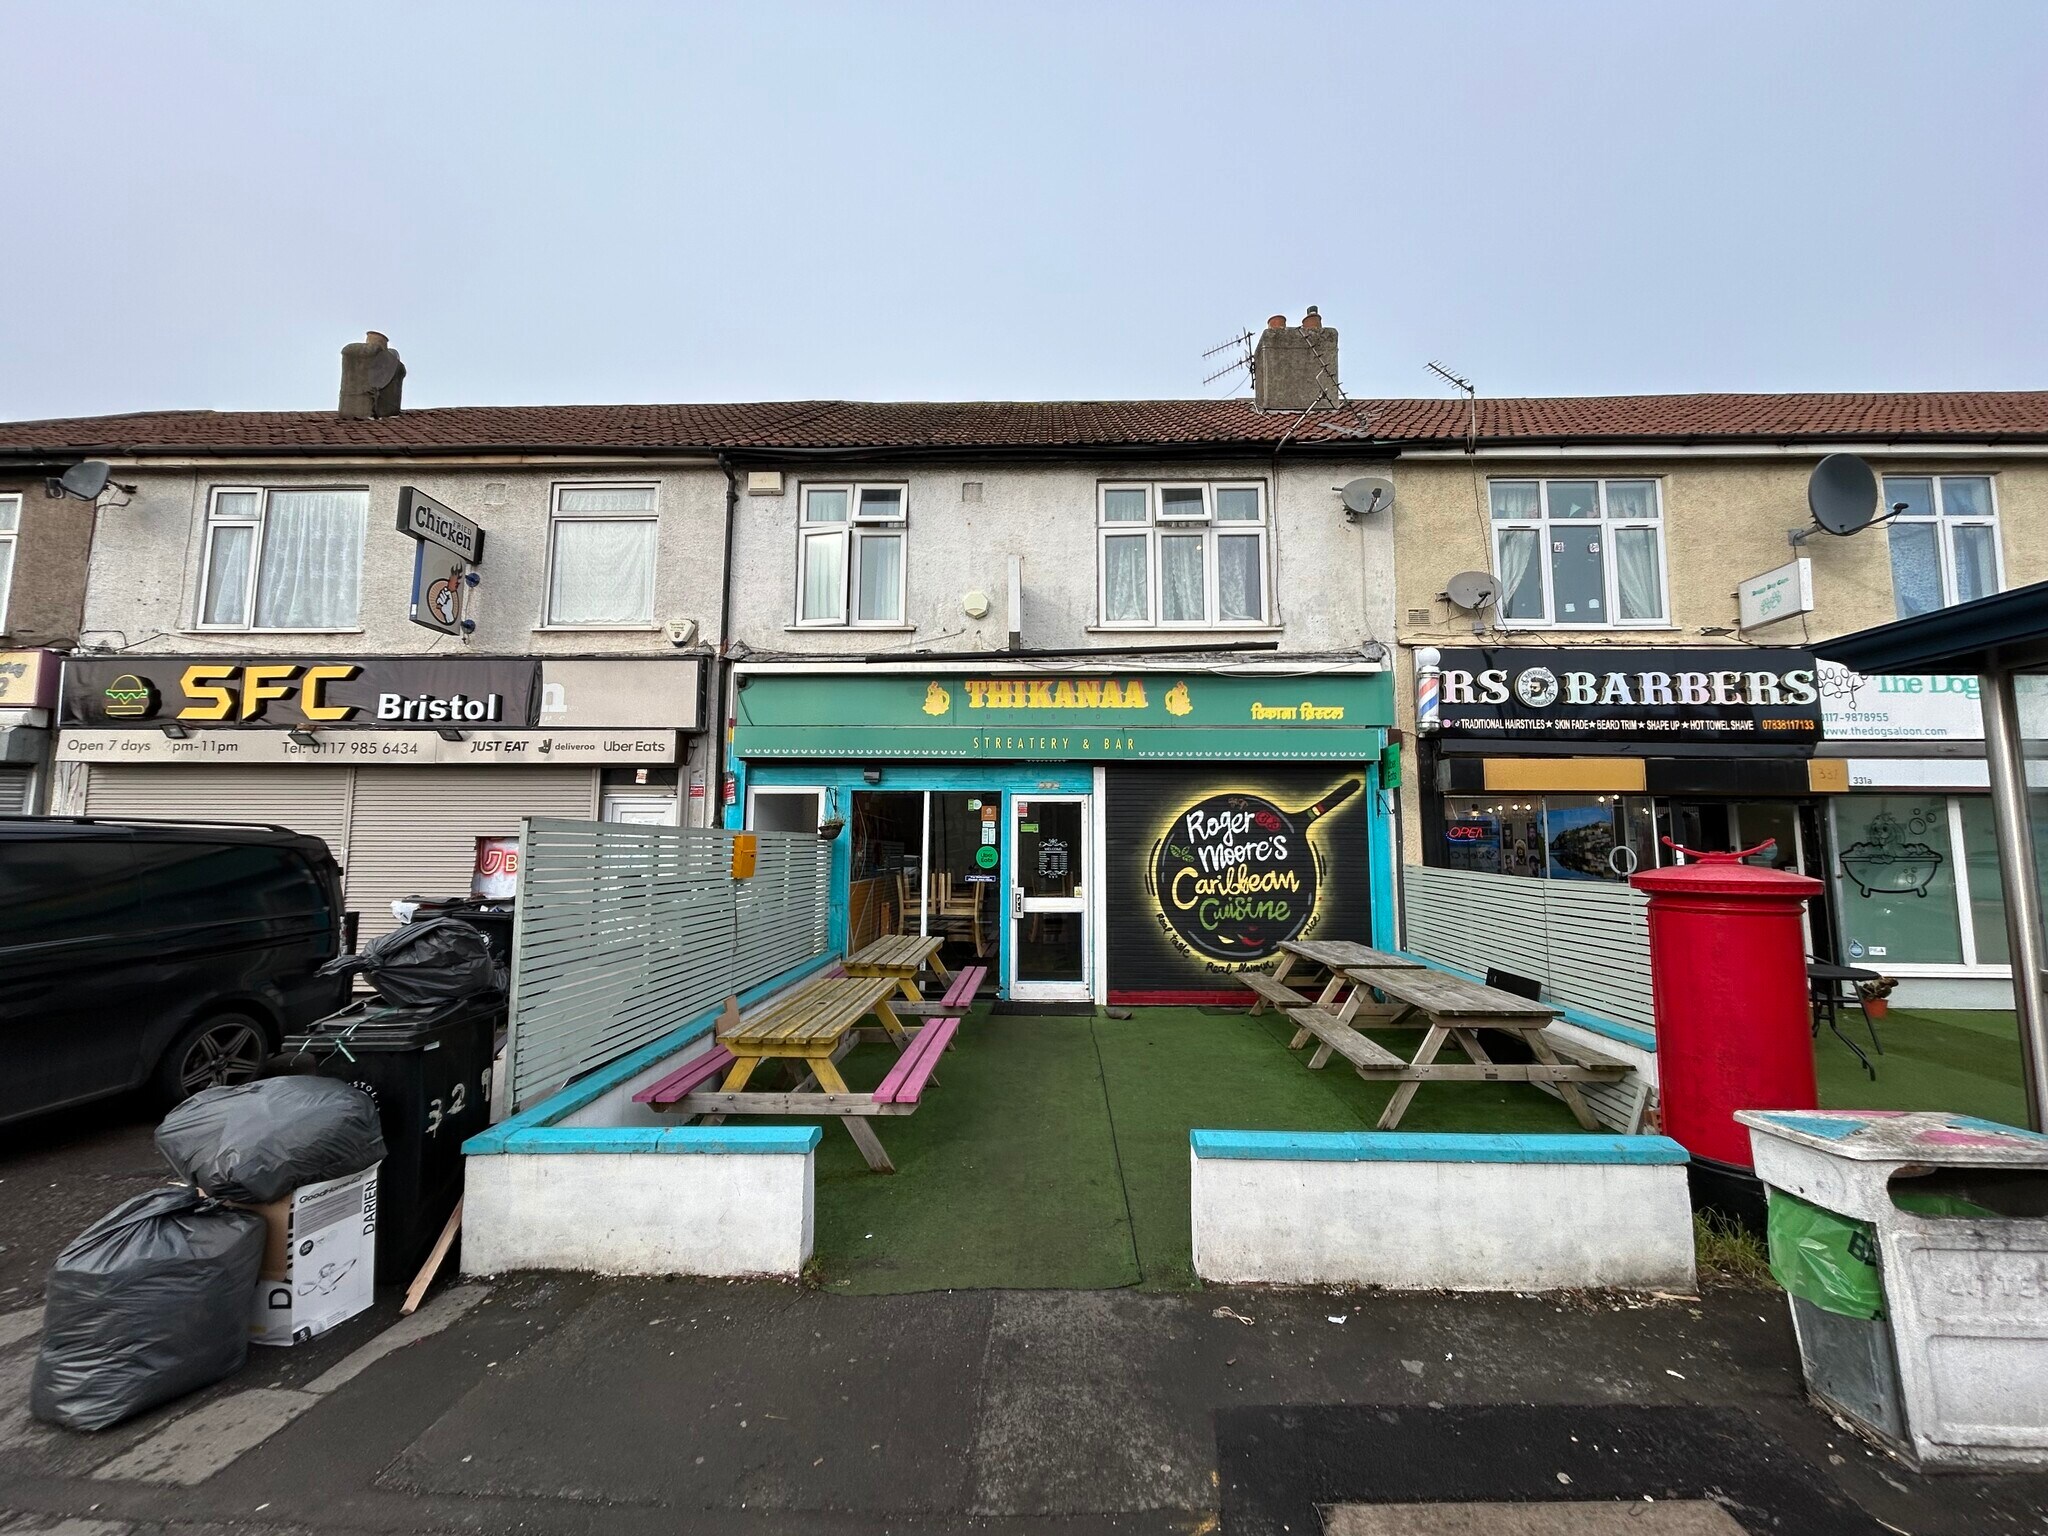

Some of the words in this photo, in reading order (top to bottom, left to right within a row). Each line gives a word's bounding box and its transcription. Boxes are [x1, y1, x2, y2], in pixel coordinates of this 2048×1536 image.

[415, 505, 471, 551] Chicken
[176, 665, 358, 719] SFC
[965, 679, 1149, 709] THIKANAA
[1440, 669, 1510, 704] RS
[1562, 671, 1818, 706] BARBERS
[1873, 675, 1923, 694] The
[1929, 675, 1980, 700] Dog
[377, 693, 500, 721] Bristol
[1460, 718, 1504, 729] TRADITIONAL
[1505, 718, 1545, 730] HAIRSTYLES
[1554, 719, 1570, 730] SKIN
[1571, 719, 1589, 730] FADE
[1596, 719, 1620, 730] BEARD
[1620, 719, 1638, 730] TRIM
[1646, 720, 1670, 730] SHAPE
[1670, 720, 1680, 730] UP
[1690, 720, 1705, 730] HOT
[1705, 720, 1730, 730] TOWEL
[1731, 720, 1754, 730] SHAVE
[1762, 720, 1815, 730] 07838117133
[67, 739, 104, 754] Open
[108, 739, 118, 751] 7
[121, 738, 151, 754] days
[282, 741, 307, 754] Tel:
[312, 742, 346, 755] 0117
[350, 742, 377, 755] 985
[382, 742, 419, 755] 6434
[471, 741, 502, 753] JUST
[504, 741, 529, 753] EAT
[554, 742, 596, 751] deliveroo
[603, 741, 634, 752] Uber
[635, 741, 666, 752] Eats
[973, 737, 1069, 750] STREATERY
[1082, 738, 1091, 750] &
[1104, 738, 1135, 751] BAR
[1853, 776, 1873, 785] 331a
[1186, 810, 1255, 847] Roger
[1449, 826, 1484, 838] OPEN
[1172, 864, 1299, 910] Caribbean
[1200, 896, 1291, 930] Cuisine
[1156, 912, 1174, 935] Real
[1170, 933, 1191, 959] taste
[1206, 961, 1232, 975] Real
[299, 1181, 350, 1204] GoodHome
[363, 1179, 378, 1237] DARIEN
